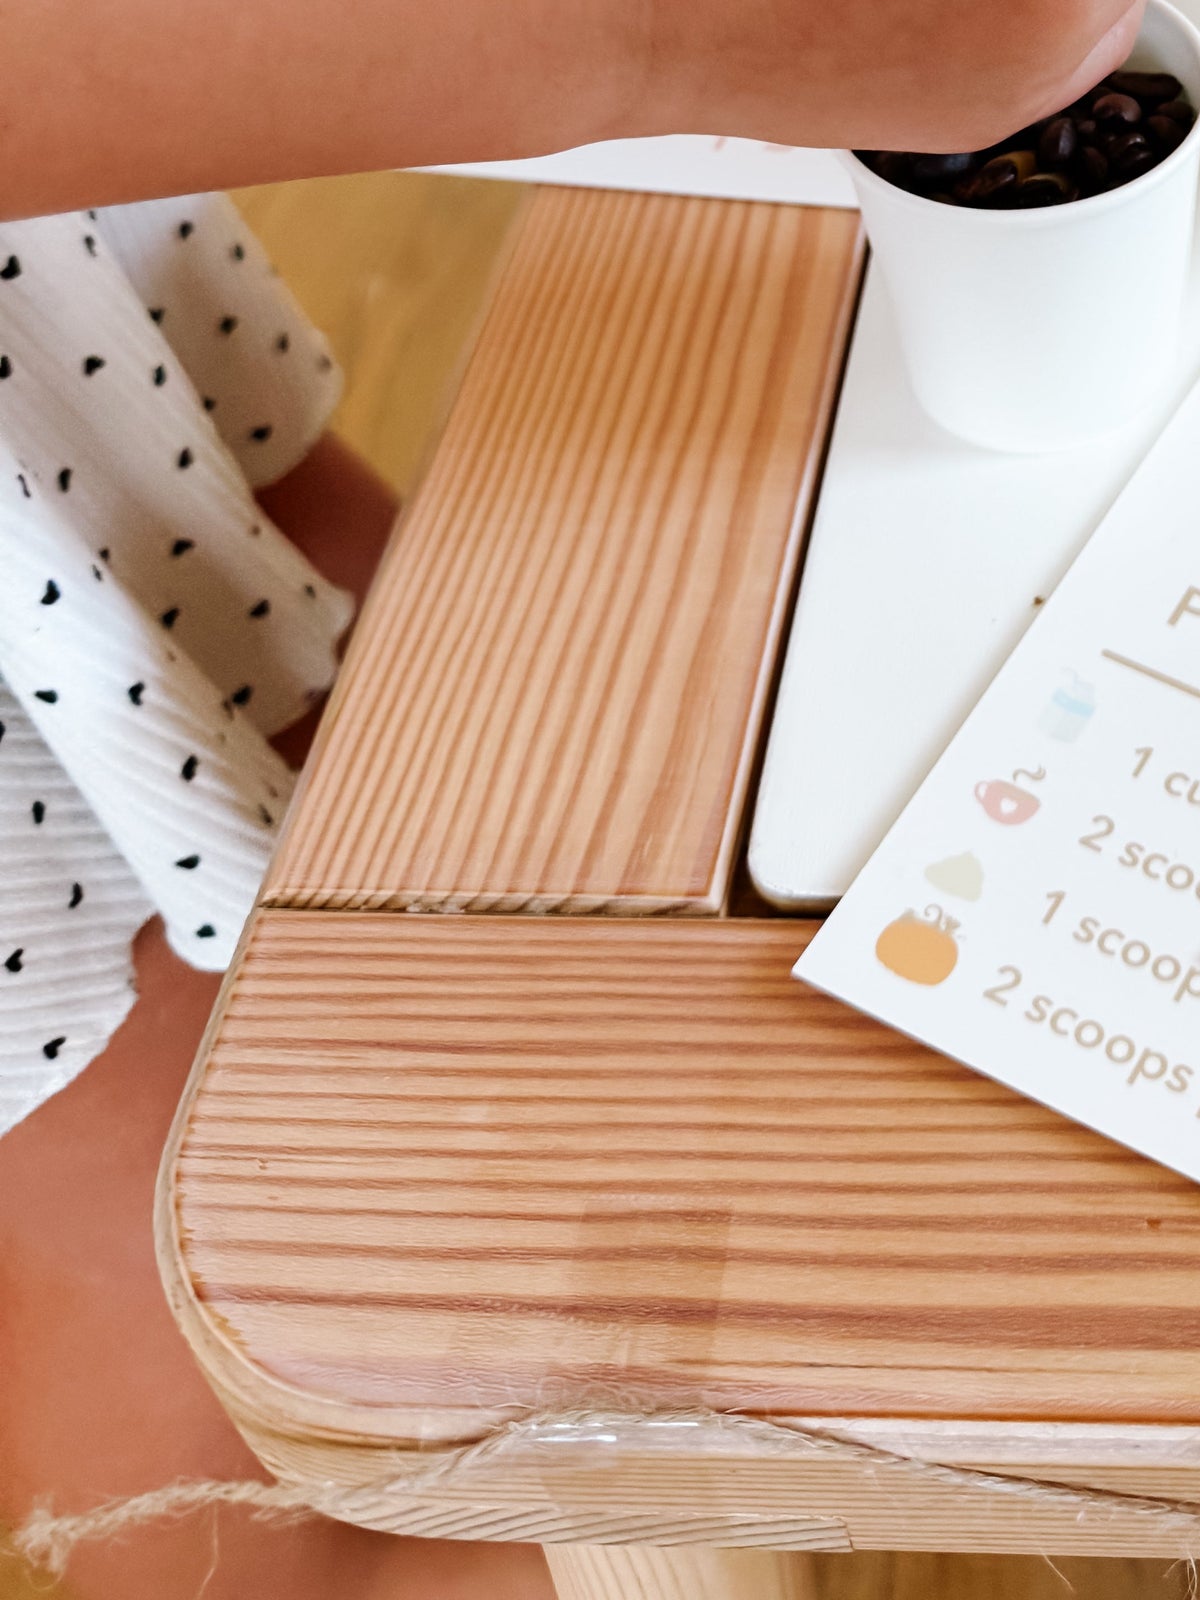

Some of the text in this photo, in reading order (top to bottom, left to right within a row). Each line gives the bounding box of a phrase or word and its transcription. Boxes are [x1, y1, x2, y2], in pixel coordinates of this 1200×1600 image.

[1132, 746, 1154, 778] 1
[1078, 814, 1115, 852] 2
[1041, 890, 1066, 926] 1
[982, 965, 1022, 1006] 2
[1025, 987, 1194, 1093] scoops
